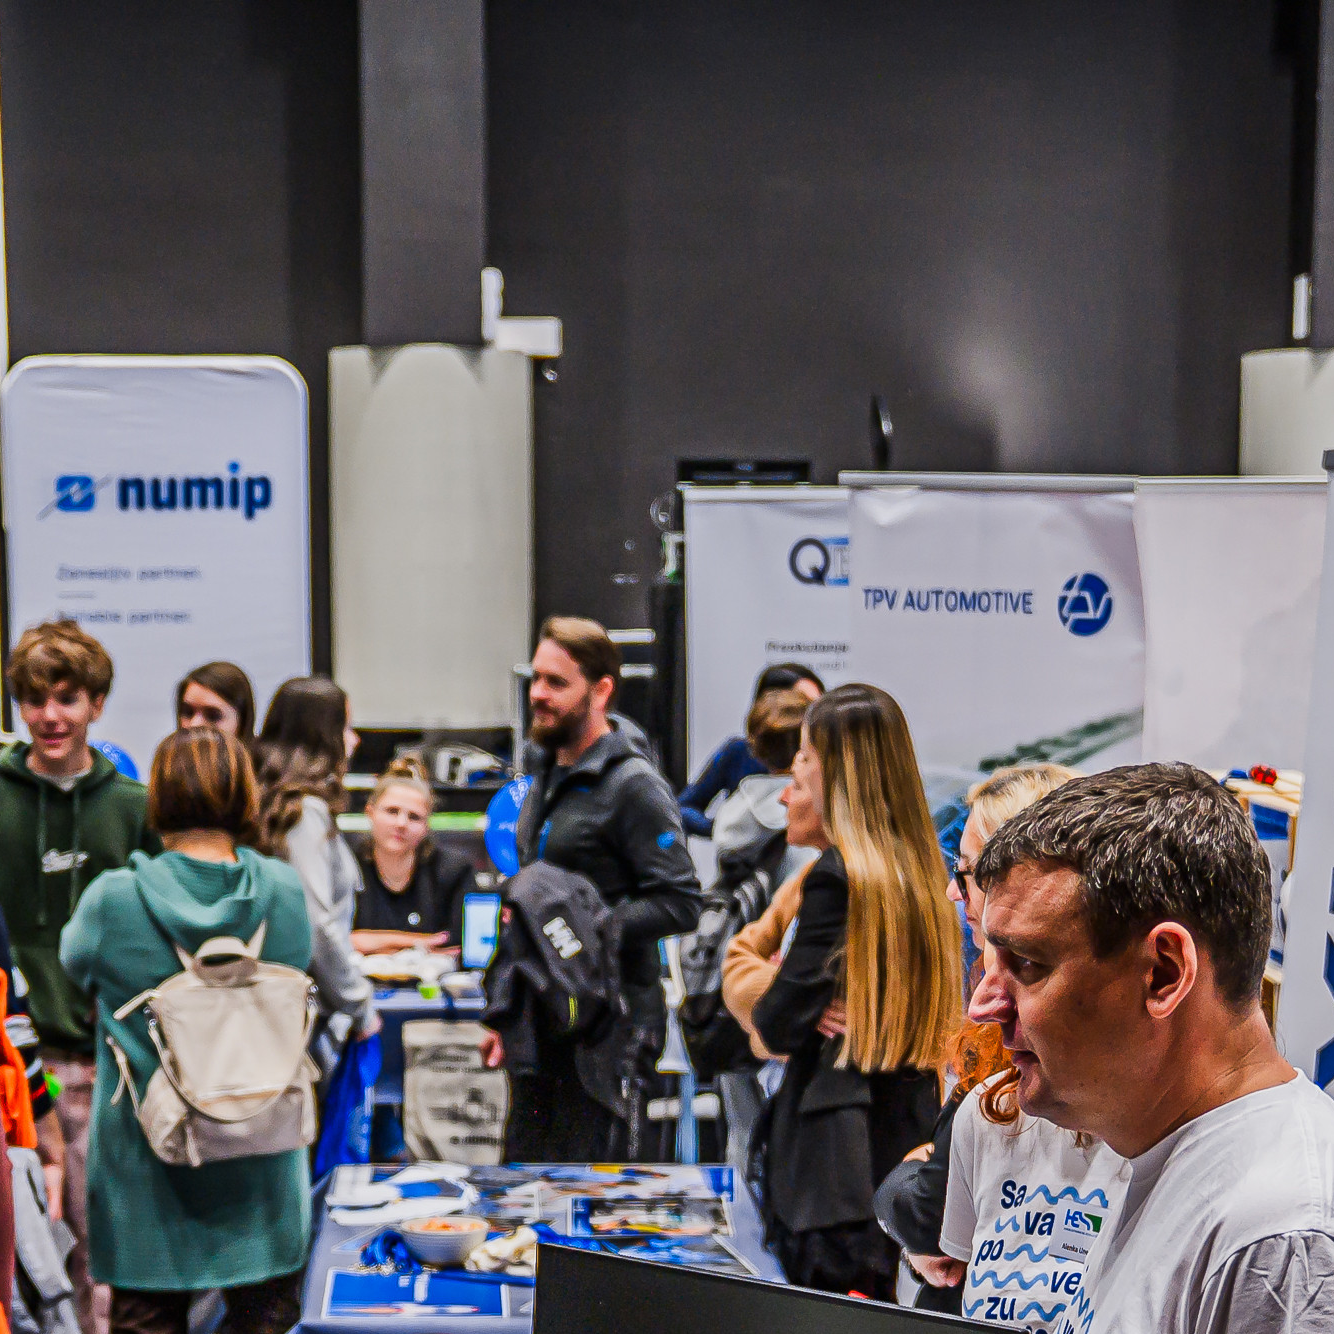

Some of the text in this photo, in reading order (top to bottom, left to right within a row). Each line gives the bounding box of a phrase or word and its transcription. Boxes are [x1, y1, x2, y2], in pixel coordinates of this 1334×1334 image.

[117, 461, 272, 520] numip
[863, 588, 1034, 614] TPV AUTOMOTIVE
[1001, 1179, 1027, 1209] Sa
[1024, 1211, 1055, 1236] va
[975, 1239, 1003, 1267] po
[1051, 1269, 1082, 1295] ve
[985, 1296, 1015, 1321] zu
